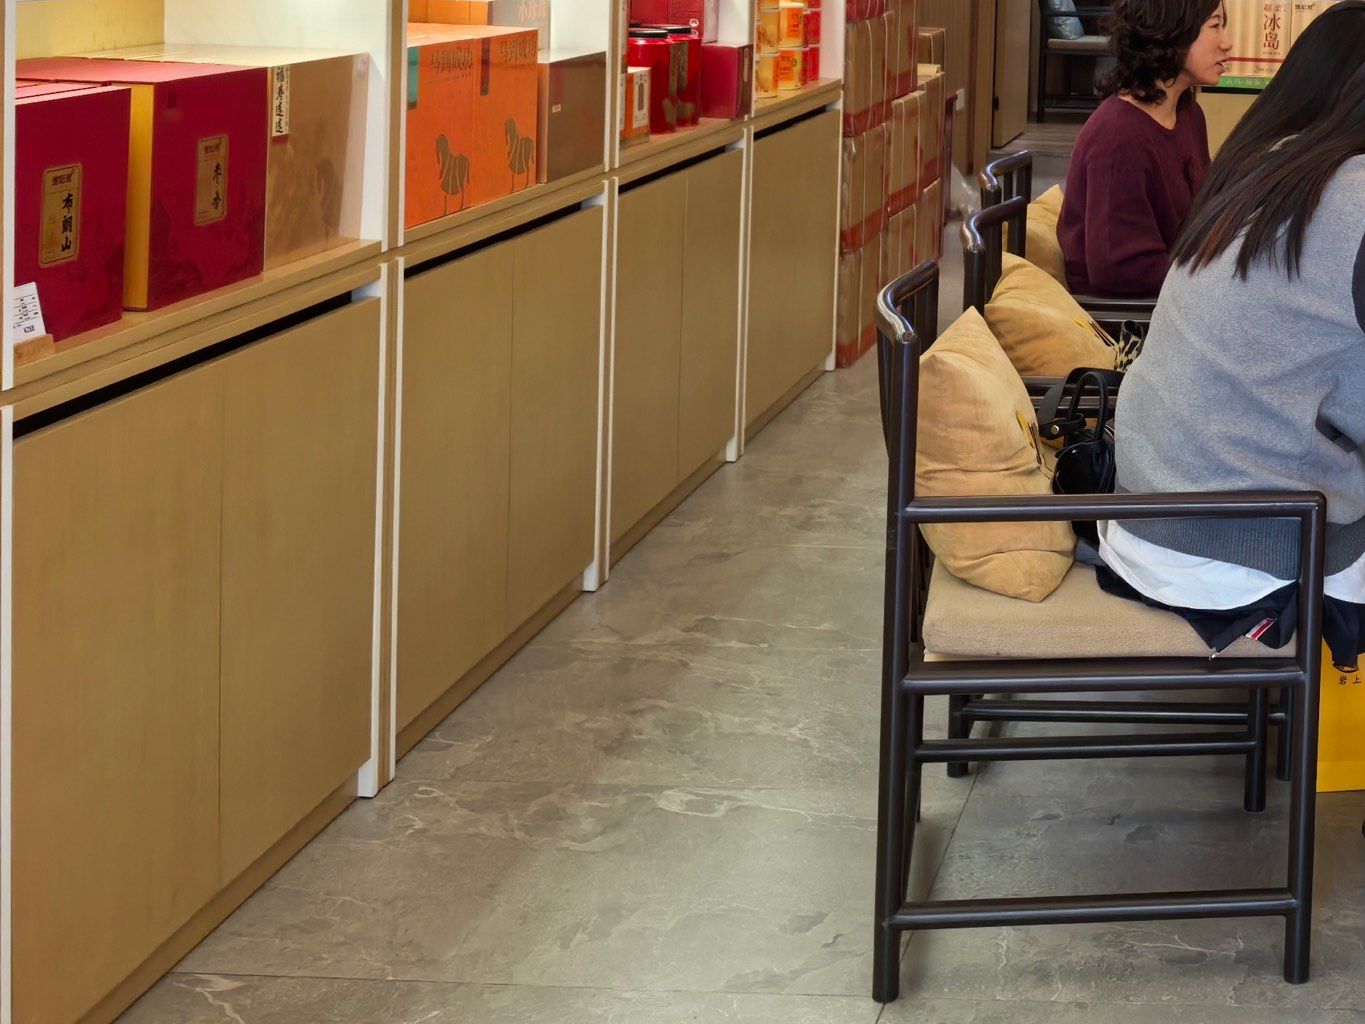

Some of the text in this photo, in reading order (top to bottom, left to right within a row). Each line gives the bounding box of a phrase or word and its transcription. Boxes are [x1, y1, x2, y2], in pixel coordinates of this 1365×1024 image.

[1263, 14, 1281, 51] 冰岛
[61, 192, 74, 253] 布朗山
